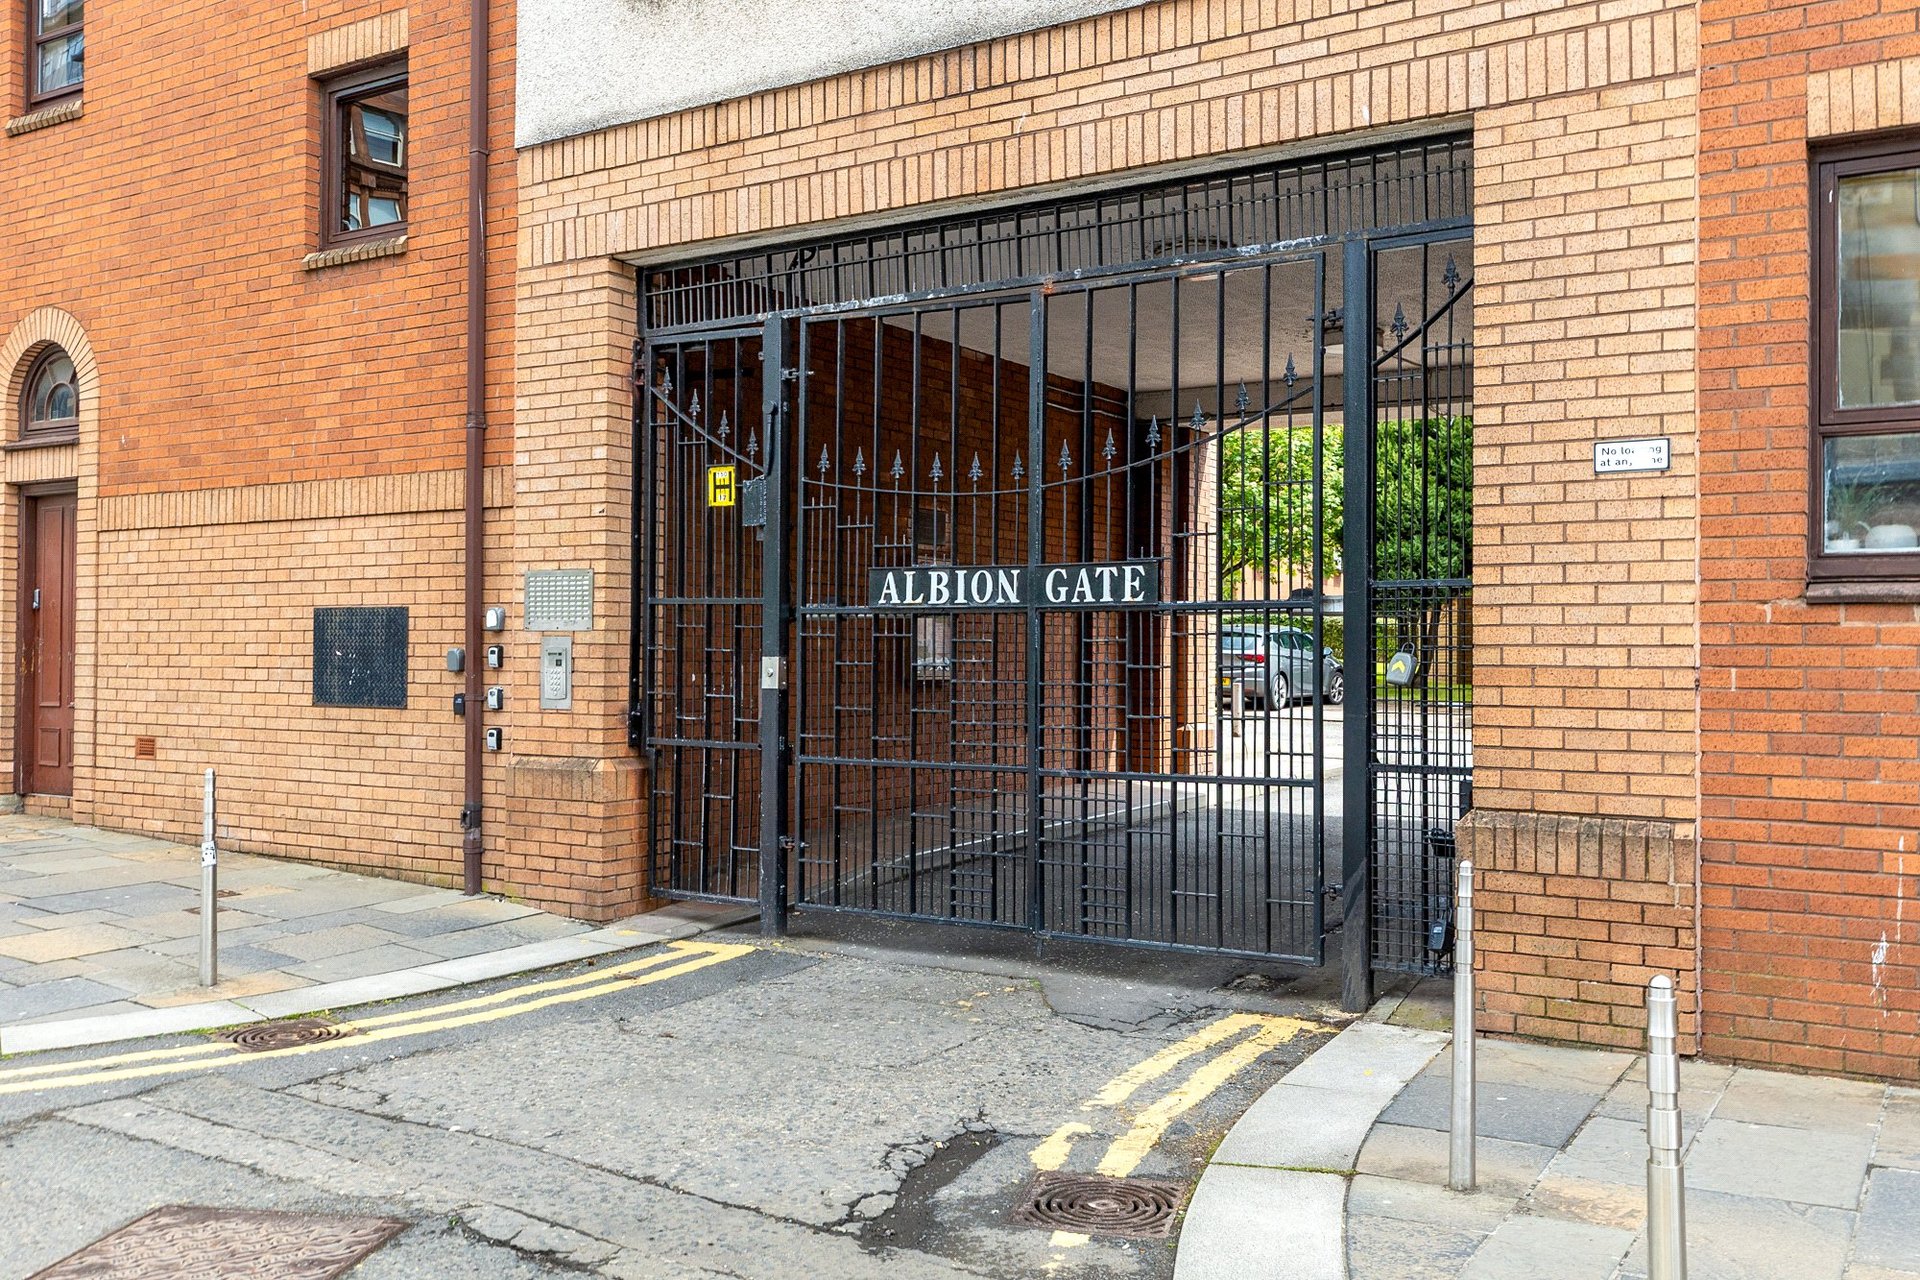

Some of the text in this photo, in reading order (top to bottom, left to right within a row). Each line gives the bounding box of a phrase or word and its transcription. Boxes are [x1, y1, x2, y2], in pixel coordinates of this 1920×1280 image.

[1601, 447, 1617, 456] No
[1600, 458, 1611, 467] at
[878, 565, 1146, 605] ALBION GATE
